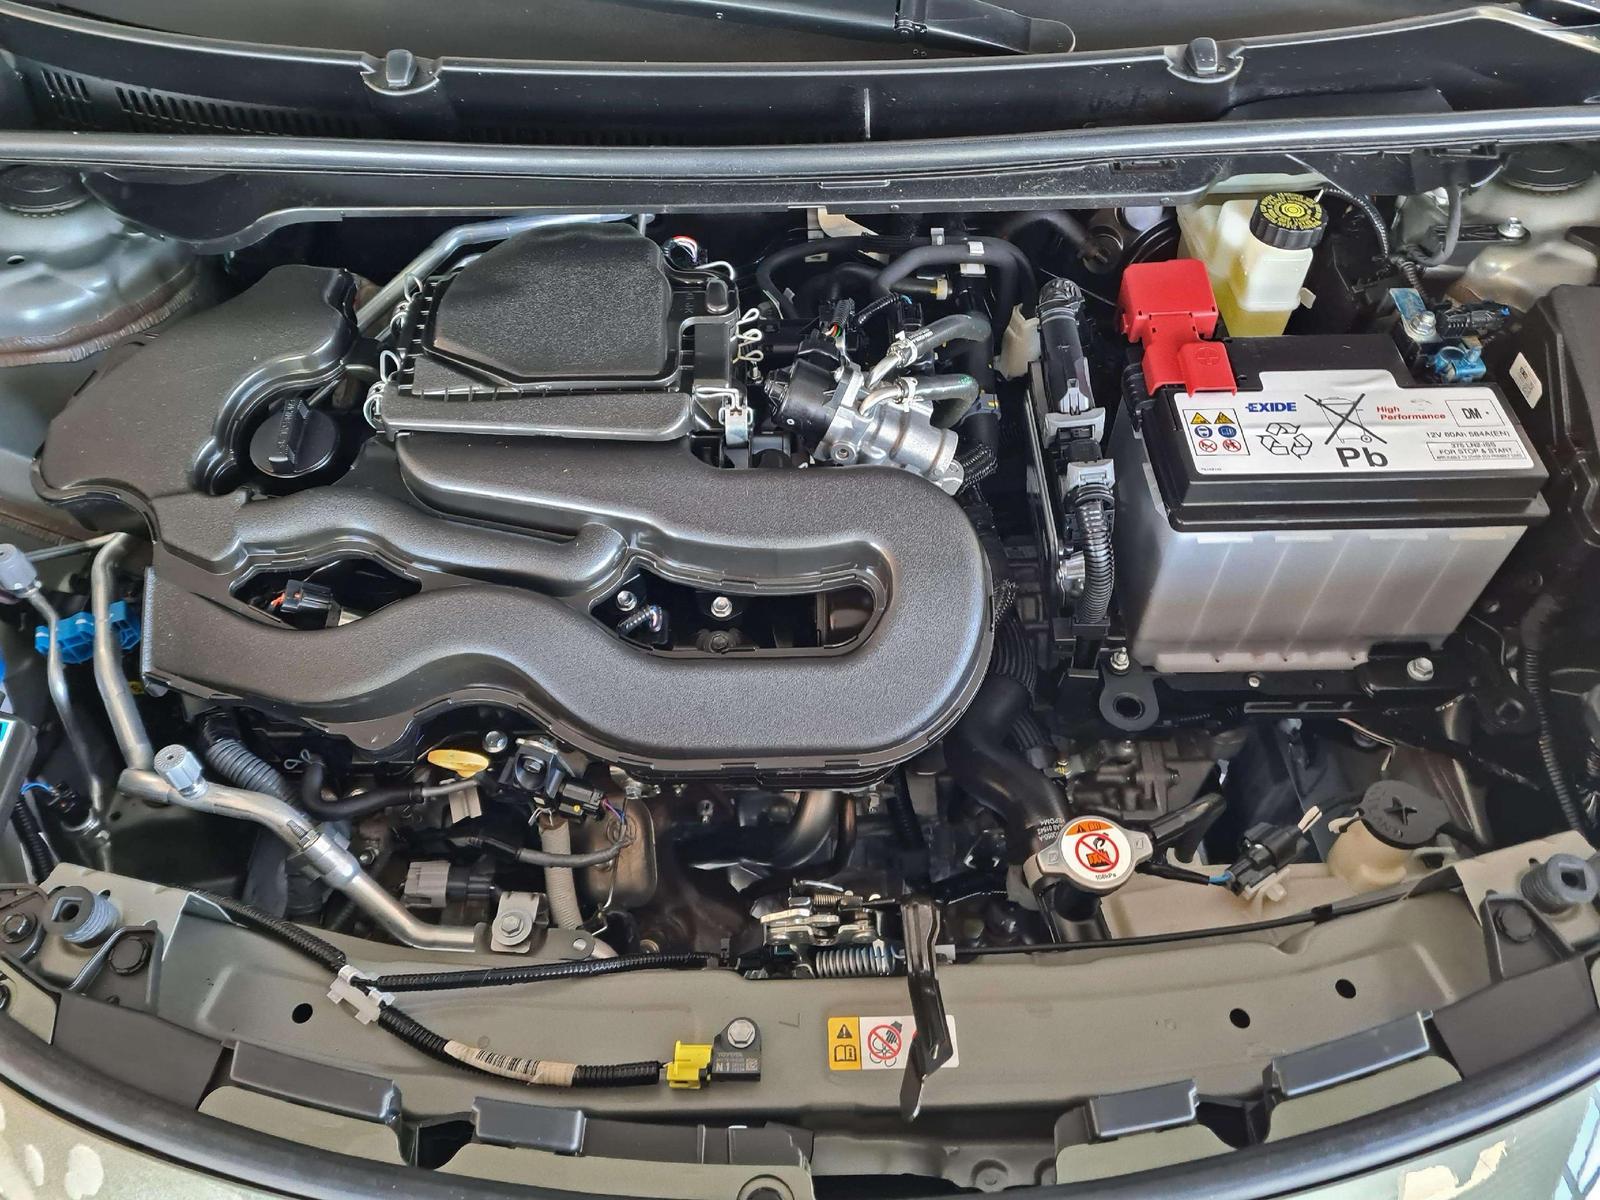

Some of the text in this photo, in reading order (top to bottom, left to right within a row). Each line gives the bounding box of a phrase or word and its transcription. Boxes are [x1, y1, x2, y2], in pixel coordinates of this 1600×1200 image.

[1247, 401, 1297, 413] EXIDE
[1376, 406, 1400, 414] High
[1380, 413, 1447, 421] Performance
[1461, 407, 1483, 420] DM
[1426, 431, 1442, 439] 12V
[1335, 446, 1389, 468] Pb
